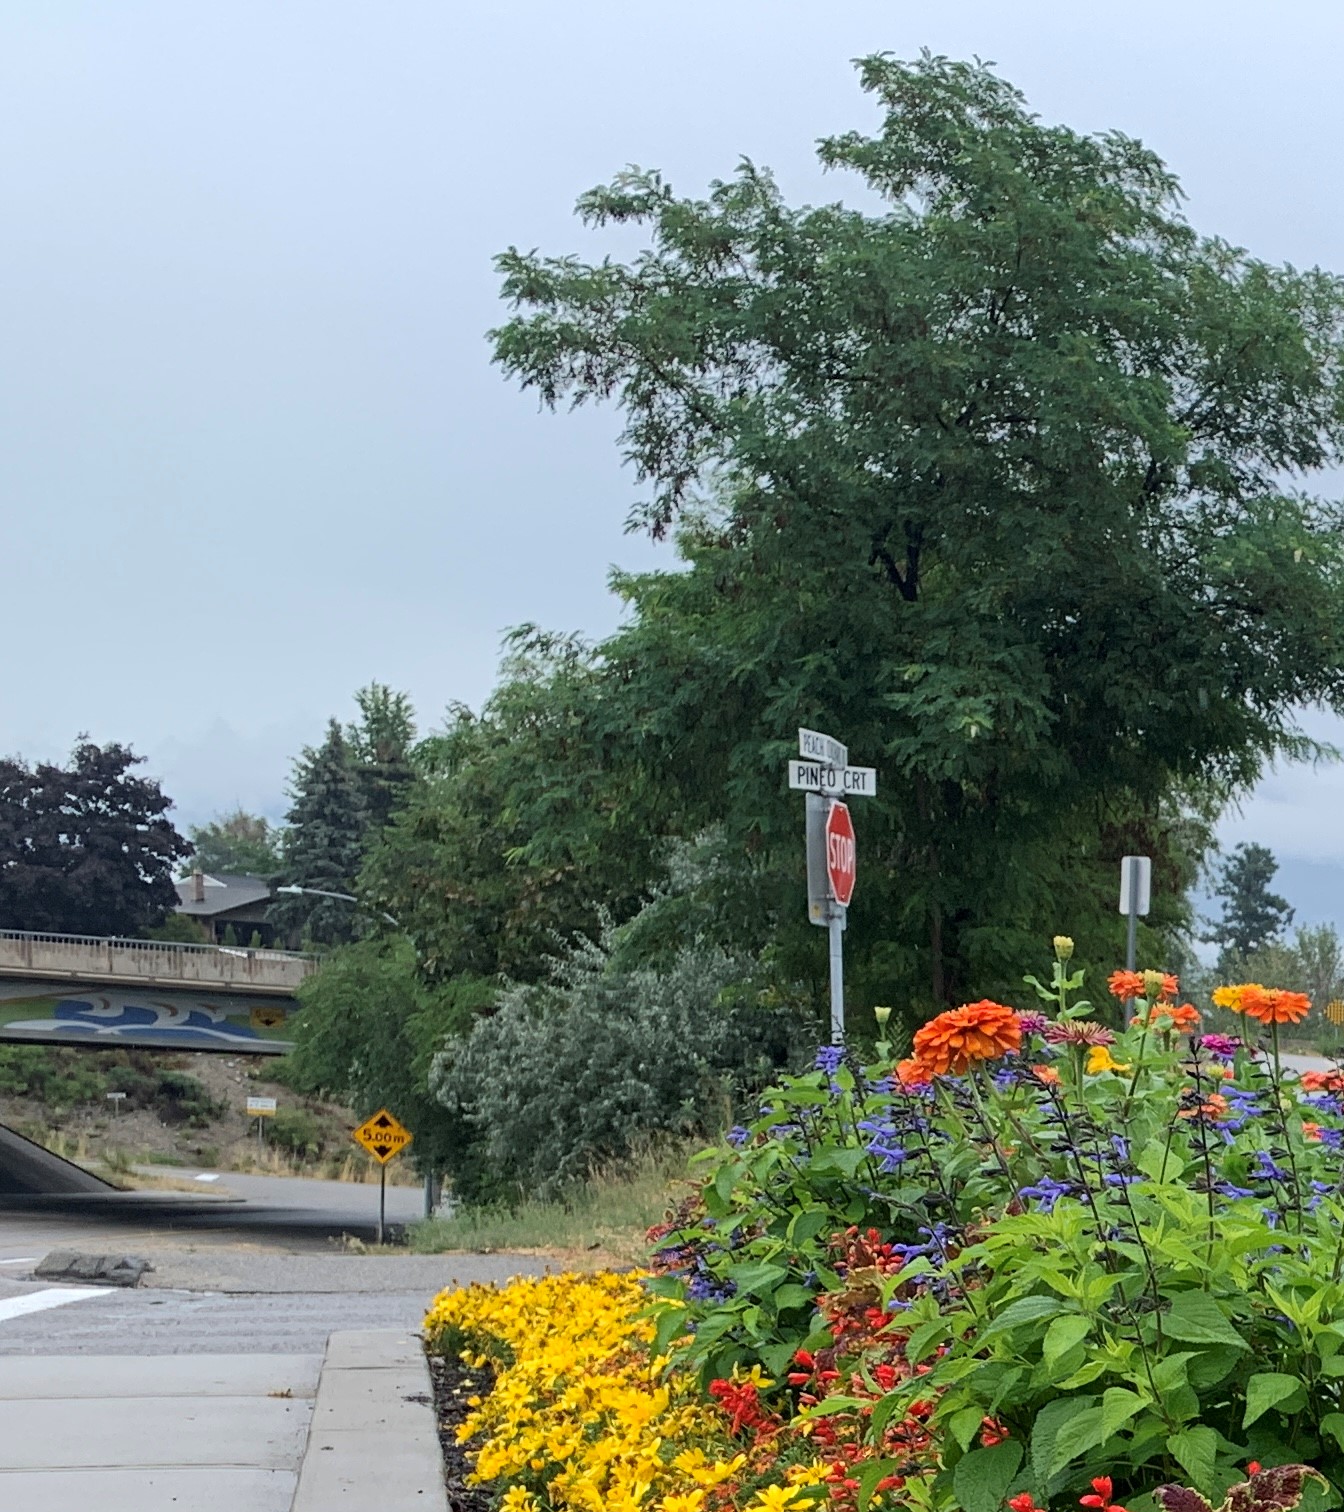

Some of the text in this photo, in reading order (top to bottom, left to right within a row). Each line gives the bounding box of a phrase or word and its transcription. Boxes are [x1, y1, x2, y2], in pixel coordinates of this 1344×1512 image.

[797, 766, 867, 790] PINEO CRT
[830, 831, 853, 875] STOP
